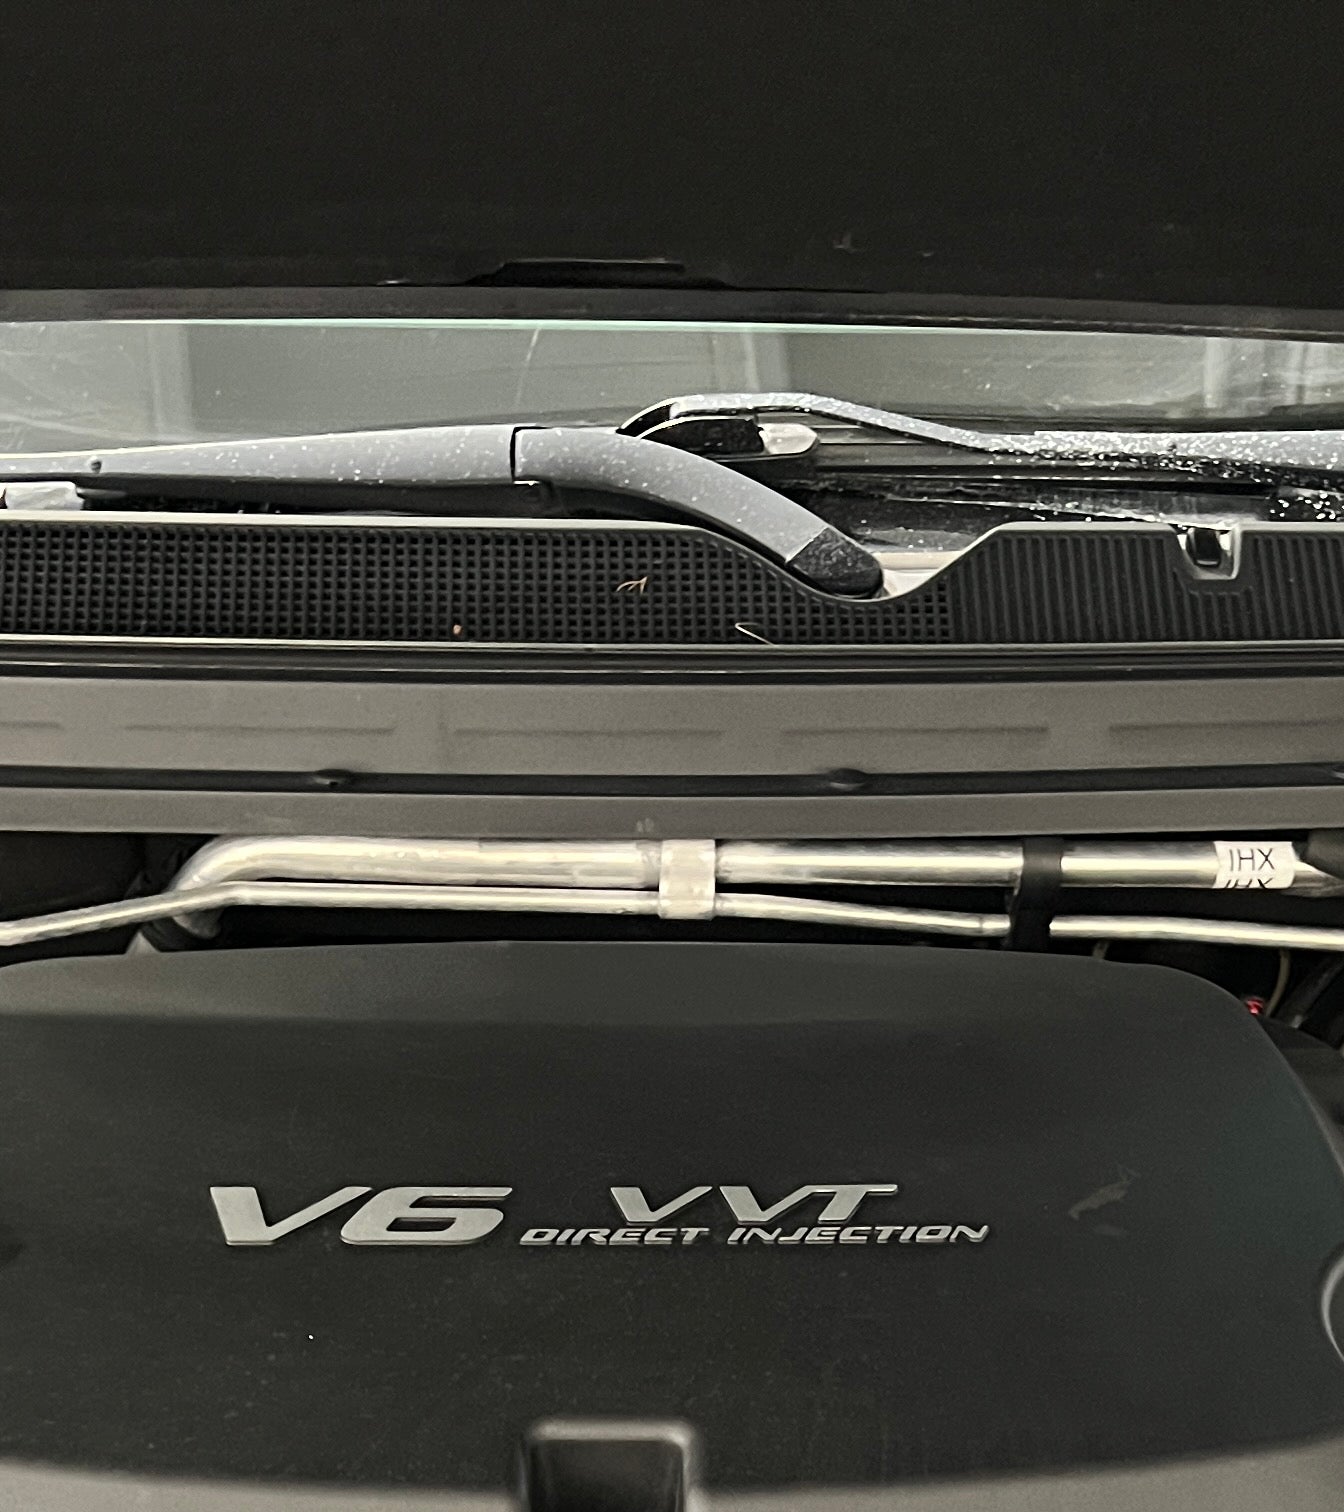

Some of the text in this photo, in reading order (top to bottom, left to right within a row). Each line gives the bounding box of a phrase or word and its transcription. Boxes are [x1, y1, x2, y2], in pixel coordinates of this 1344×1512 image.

[1229, 847, 1275, 872] IHX
[210, 1184, 899, 1246] V6 VVT
[519, 1223, 990, 1247] DIRECT INJECTION
